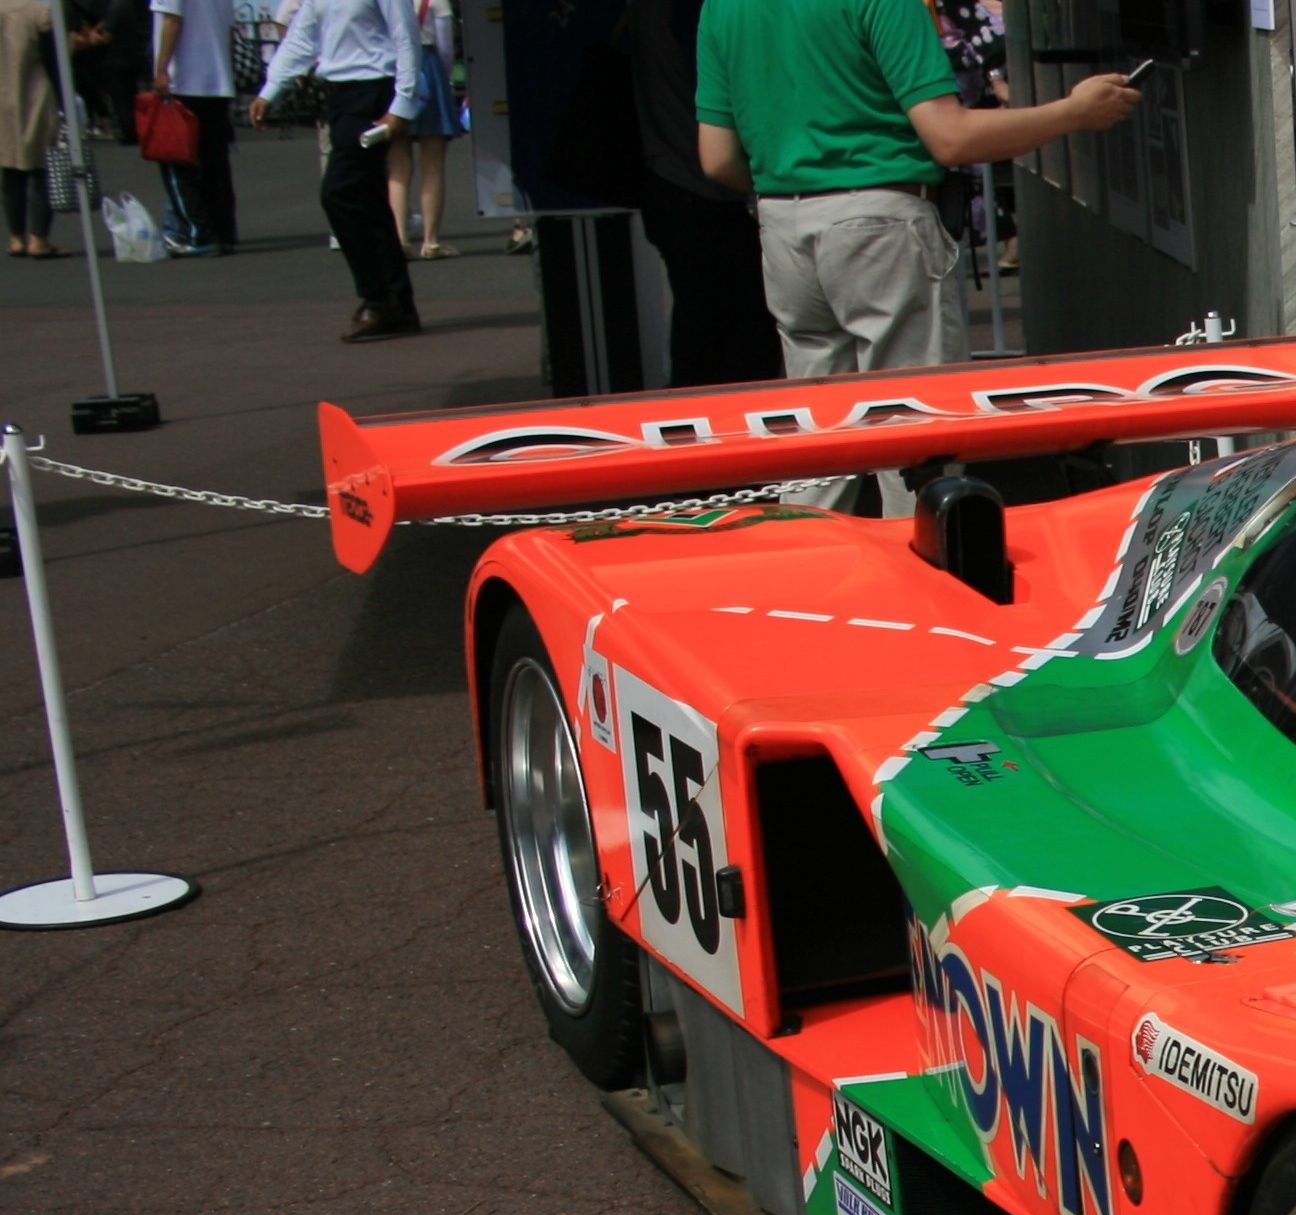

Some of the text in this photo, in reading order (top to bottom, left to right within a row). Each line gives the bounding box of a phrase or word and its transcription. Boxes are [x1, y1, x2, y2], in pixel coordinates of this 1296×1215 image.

[630, 710, 720, 955] 55
[1128, 922, 1279, 952] PLAYSURE
[1158, 1036, 1254, 1117] IDEMITSU
[834, 1094, 888, 1184] NGK
[840, 1152, 892, 1206] SPARK PLUGS
